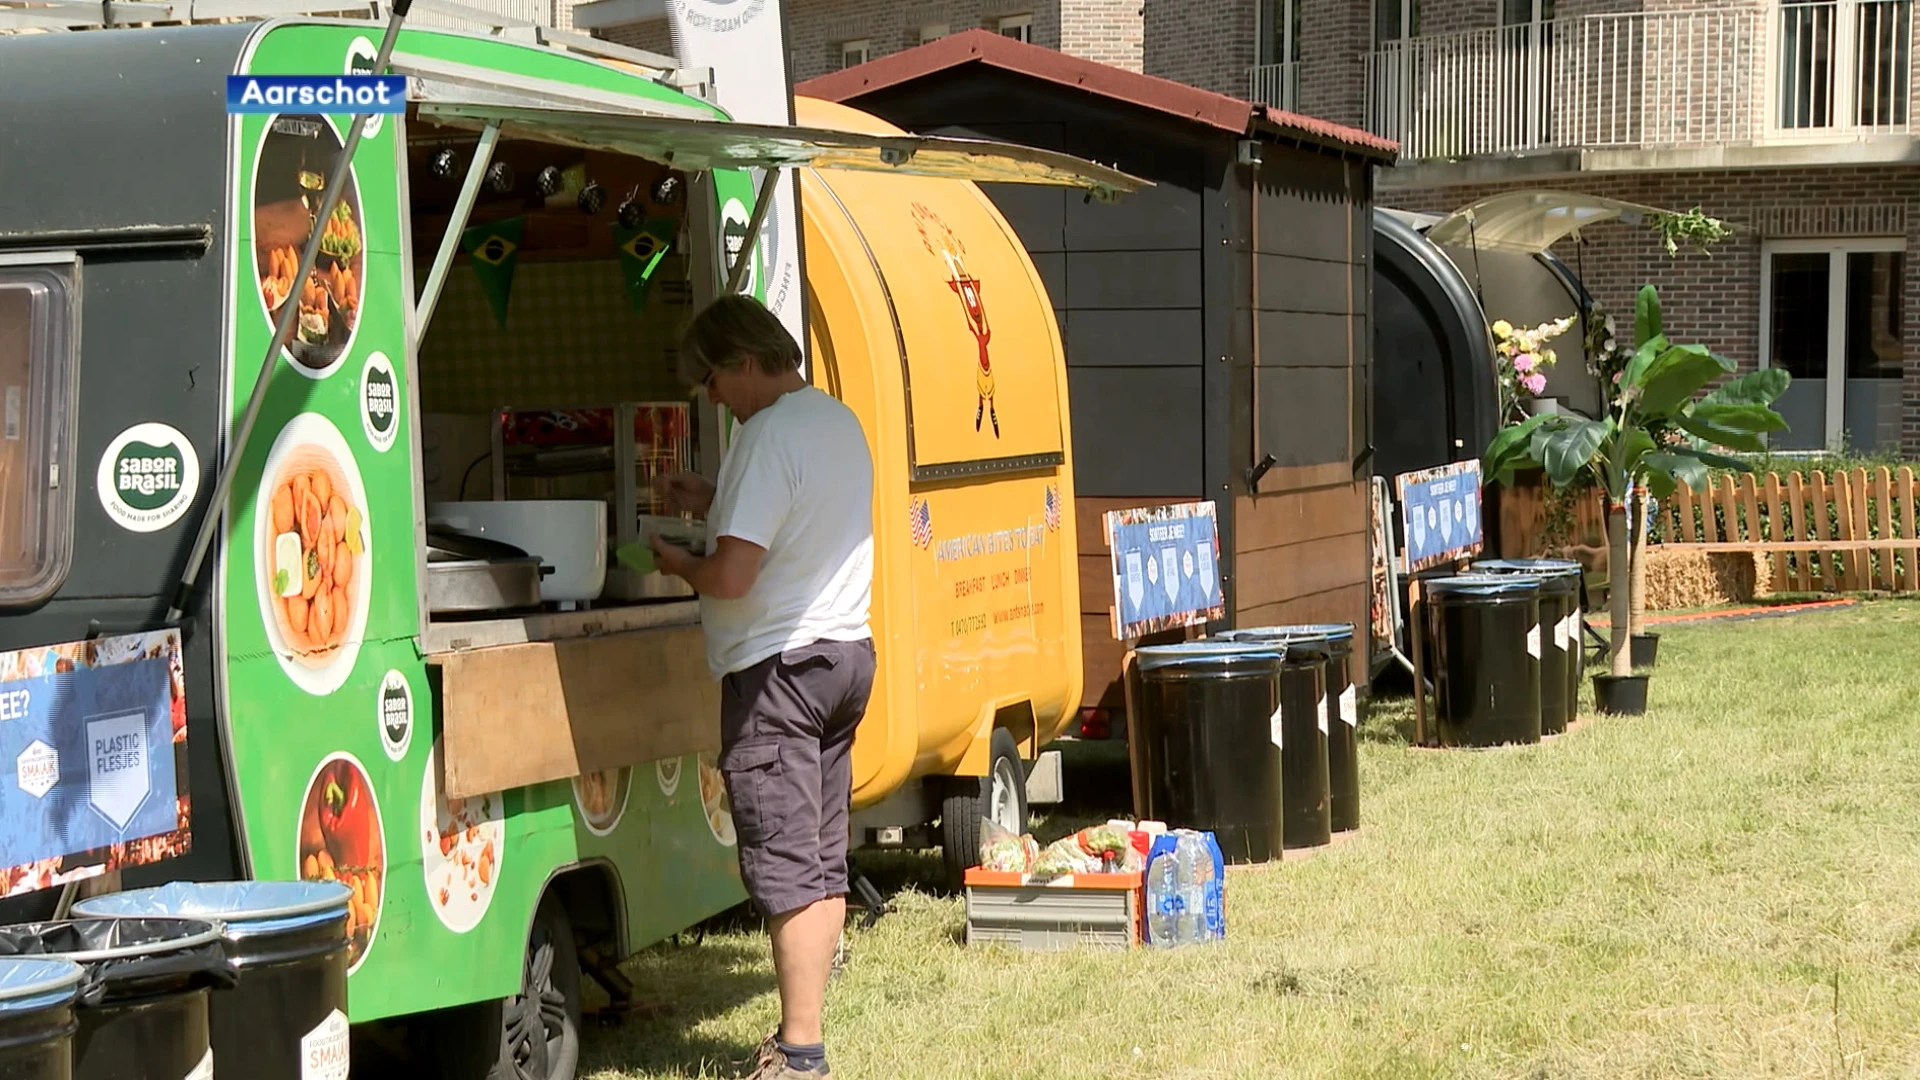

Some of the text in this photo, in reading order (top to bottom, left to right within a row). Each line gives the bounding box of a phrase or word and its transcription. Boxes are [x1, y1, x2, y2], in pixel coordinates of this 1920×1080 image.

[110, 494, 188, 522] FOOD MADE FOR SHARING
[937, 524, 1045, 562] AMERICAN BITES TO EAT
[955, 576, 986, 598] BREAKFAST
[991, 571, 1010, 590] LUNCH
[95, 733, 140, 756] PLASTIC
[97, 751, 140, 775] FLESJES
